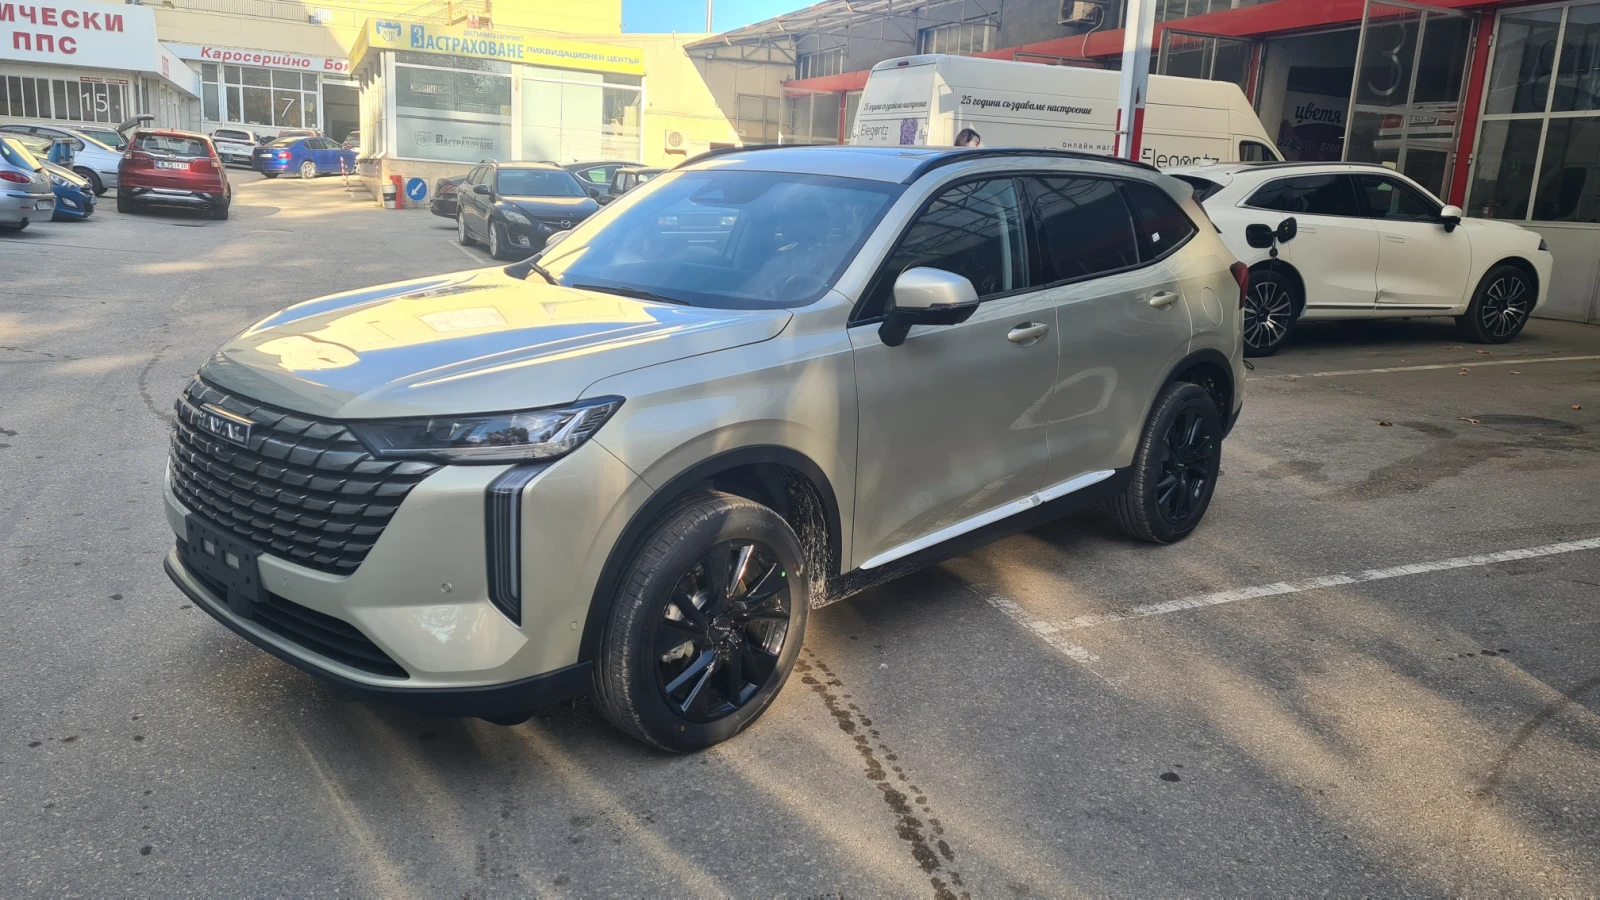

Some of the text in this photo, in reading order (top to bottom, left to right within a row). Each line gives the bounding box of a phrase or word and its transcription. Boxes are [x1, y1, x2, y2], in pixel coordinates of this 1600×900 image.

[0, 3, 124, 33] ИЧЕСКИ
[13, 31, 77, 54] ППС
[410, 24, 524, 59] ЗАСТРАХОВАНЕ
[200, 46, 311, 68] Каросерийно
[526, 46, 640, 65] ЛИКВИДАЦИОНЕН ЦЕНТЪР
[82, 92, 108, 112] 15
[281, 97, 296, 118] 7
[960, 94, 1092, 115] 25 години създаваме настроение
[1295, 102, 1342, 124] цветя
[1062, 141, 1094, 150] онлайн
